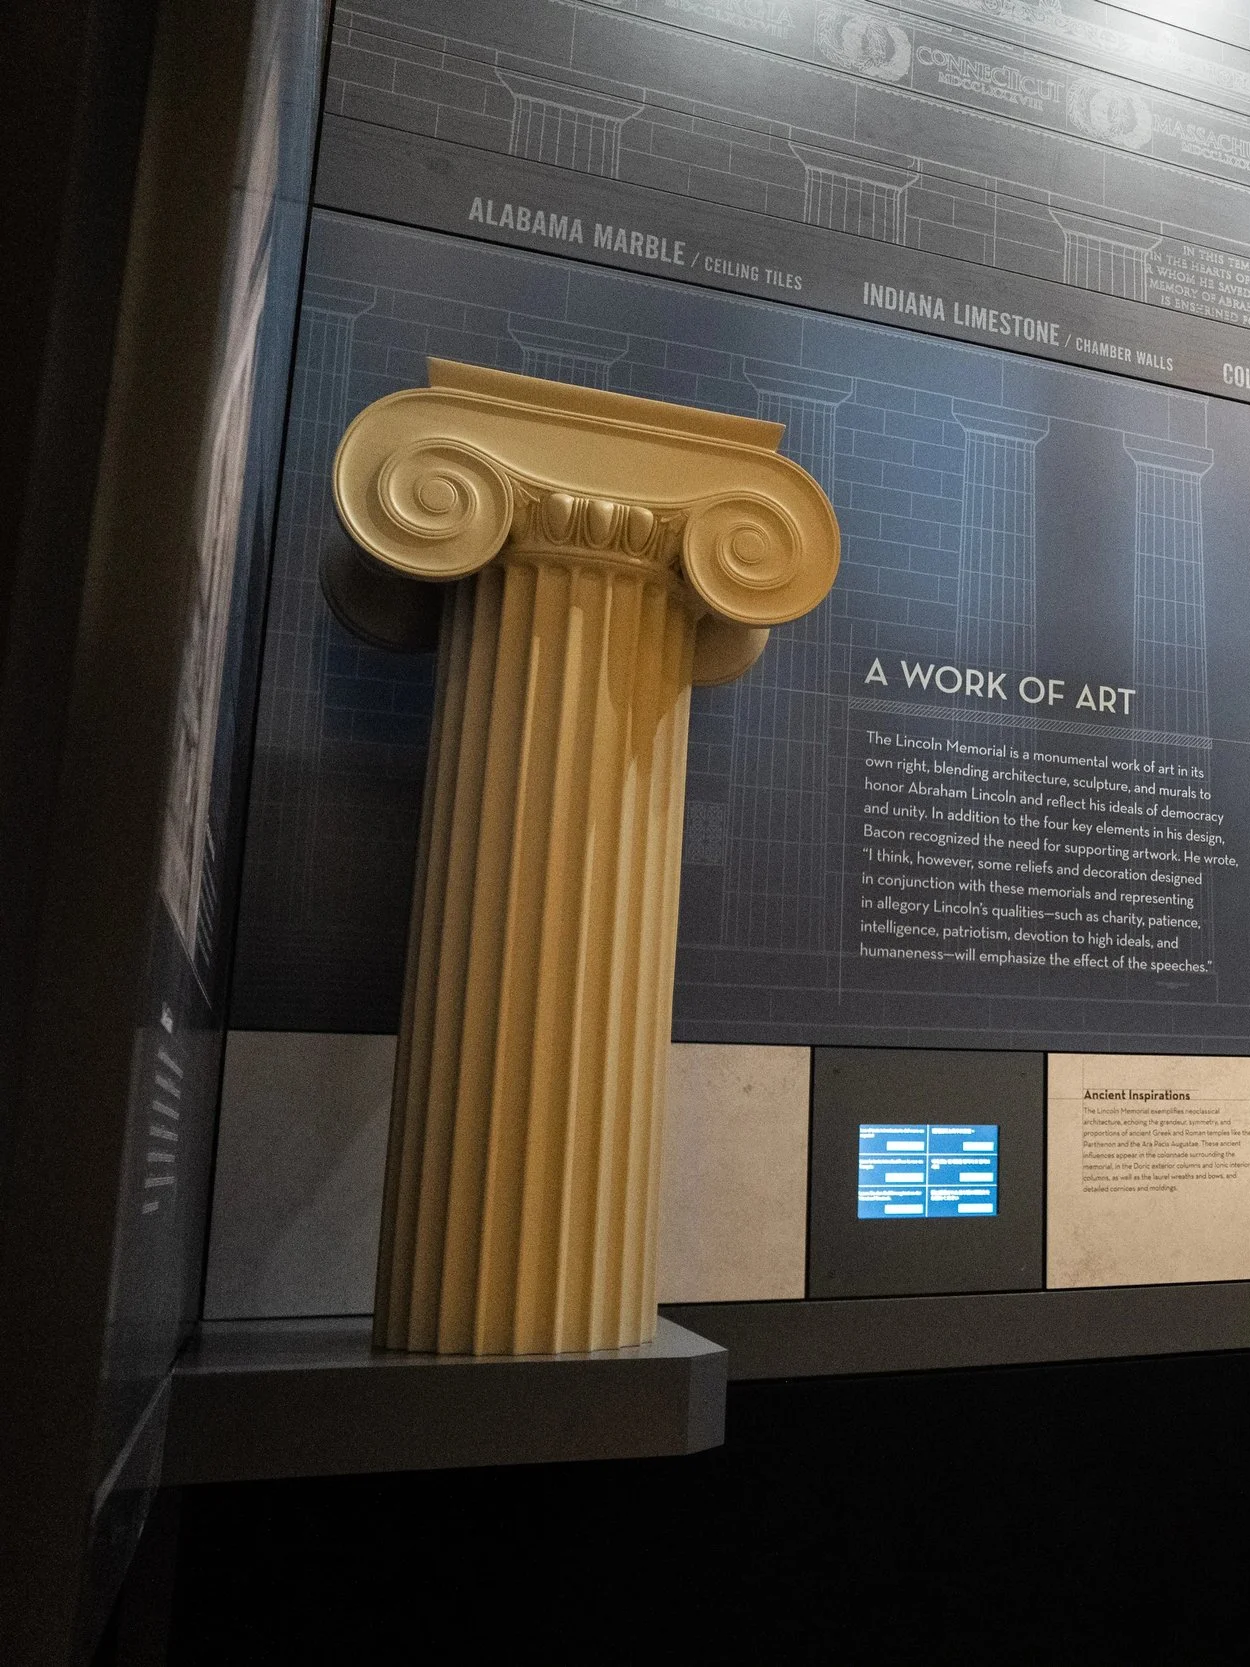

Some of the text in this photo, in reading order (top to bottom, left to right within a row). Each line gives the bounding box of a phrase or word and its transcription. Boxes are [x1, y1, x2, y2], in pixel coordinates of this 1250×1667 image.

[916, 45, 1065, 103] CONNECTICUT
[468, 197, 803, 291] ALABAMA MARBLE CEILING TILES
[1183, 246, 1195, 257] IN
[1199, 249, 1224, 265] THIS
[1150, 278, 1198, 301] MEMORY
[1157, 265, 1196, 285] WHOM
[1166, 255, 1188, 270] THE
[1191, 260, 1232, 280] HEARTS
[1235, 273, 1250, 285] OF
[1161, 295, 1171, 306] IS
[863, 281, 1174, 372] INDIANA LIMESTONE CHAMBER WALLS
[864, 657, 1136, 715] A WORK OF ART
[866, 730, 1205, 779] The Lincoln Memorial is a monumental work of art in its
[864, 757, 1212, 801] own right, blending architecture, sculpture, and murals to
[864, 776, 1225, 826] honor Abraham Lincoln and reflect his ideals of democracy
[863, 801, 1226, 847] and unity. In addition to the four key elements in his design,
[863, 823, 1239, 868] Bacon recognized the need for supporting artwork. He wrote,
[876, 848, 914, 866] think,
[916, 850, 975, 870] however,
[977, 860, 1013, 872] some
[1015, 859, 1054, 875] reliefs
[1056, 863, 1080, 877] and
[1082, 863, 1148, 881] decoration
[1149, 868, 1203, 887] designed
[861, 871, 1195, 910] in conjunction with these memorials and representing
[860, 895, 874, 909] in
[876, 895, 930, 916] allegory
[1085, 912, 1100, 923] as
[1101, 909, 1146, 929] charity,
[1148, 914, 1202, 930] patience,
[860, 919, 1179, 950] intelligence, patriotism, devotion to high ideals, and
[978, 949, 1047, 967] emphasize
[1049, 952, 1071, 967] the
[1072, 953, 1110, 969] effect
[1111, 954, 1125, 969] of
[1127, 956, 1148, 971] the
[1084, 1089, 1191, 1103] Ancient Inspirations
[1084, 1107, 1150, 1115] The Lincoln Memorial
